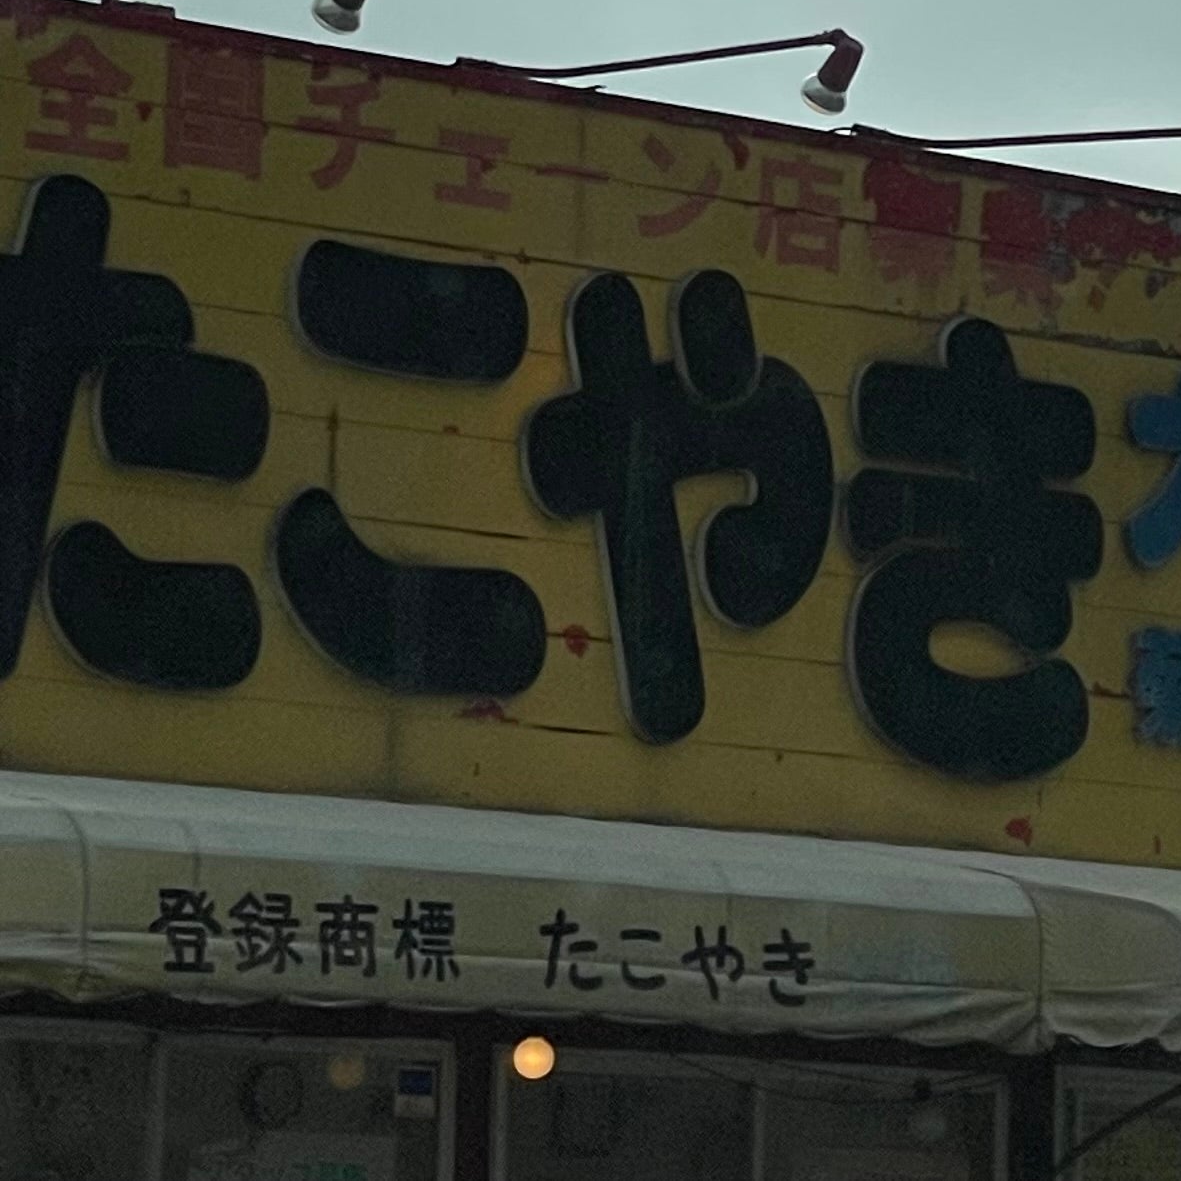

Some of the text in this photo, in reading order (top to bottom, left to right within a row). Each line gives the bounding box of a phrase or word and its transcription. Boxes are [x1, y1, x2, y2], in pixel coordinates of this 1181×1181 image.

[0, 173, 1104, 784] たこやき
[147, 888, 817, 1007] 登録商標 たこやき
